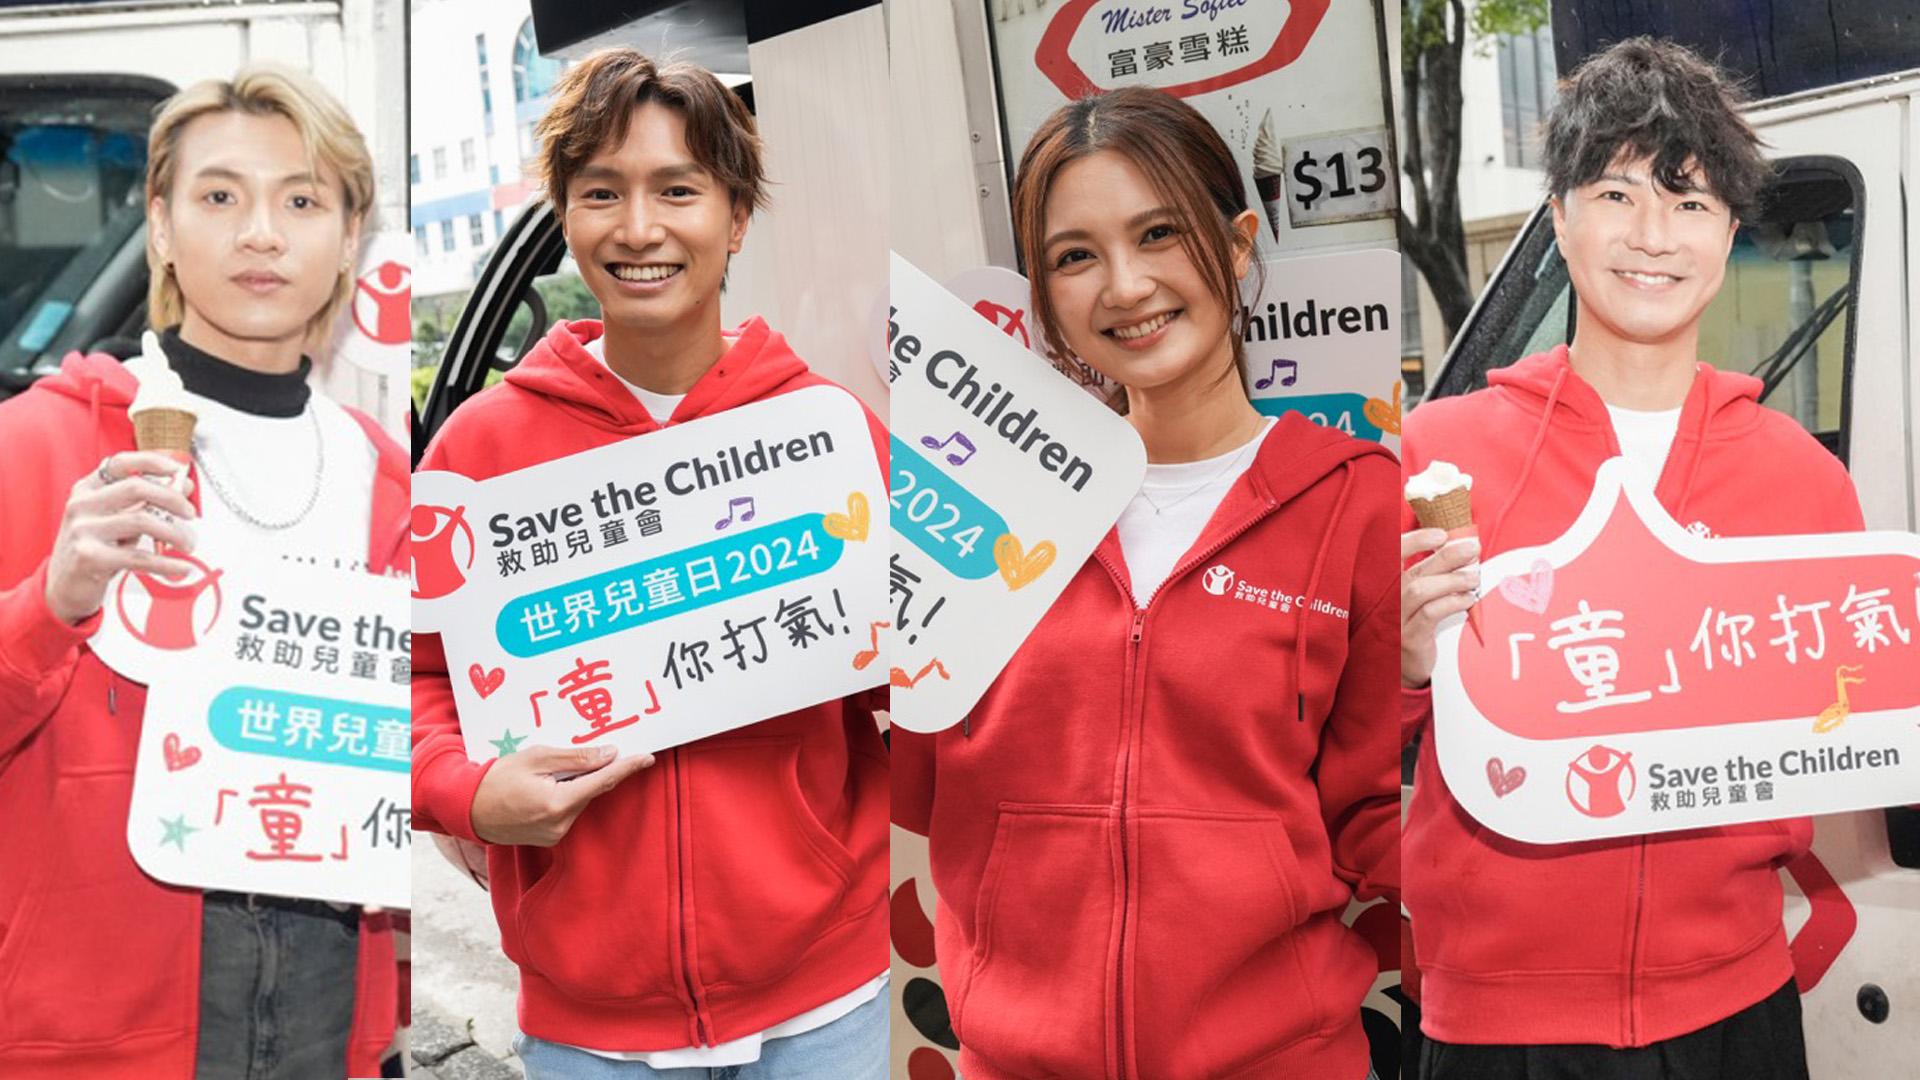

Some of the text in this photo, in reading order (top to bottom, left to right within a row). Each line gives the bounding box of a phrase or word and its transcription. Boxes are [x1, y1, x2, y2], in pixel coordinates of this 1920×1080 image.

[1101, 6, 1172, 34] Mister
[1107, 24, 1250, 79] 富豪雪糕
[1293, 146, 1386, 211] $13
[1243, 299, 1389, 342] hildren
[925, 350, 1093, 492] Children
[488, 430, 834, 549] Save the Children
[890, 470, 984, 558] 2024
[496, 508, 663, 577] 救助兒童會
[519, 530, 820, 642] 世界兒童日2024
[1237, 580, 1349, 620] Save the Cildren
[239, 595, 411, 653] Save the
[235, 636, 411, 684] 救助兒童會
[237, 700, 411, 761] 世界兒童
[1649, 743, 1900, 790] Save the Children
[1650, 780, 1775, 812] 救助兒童會
